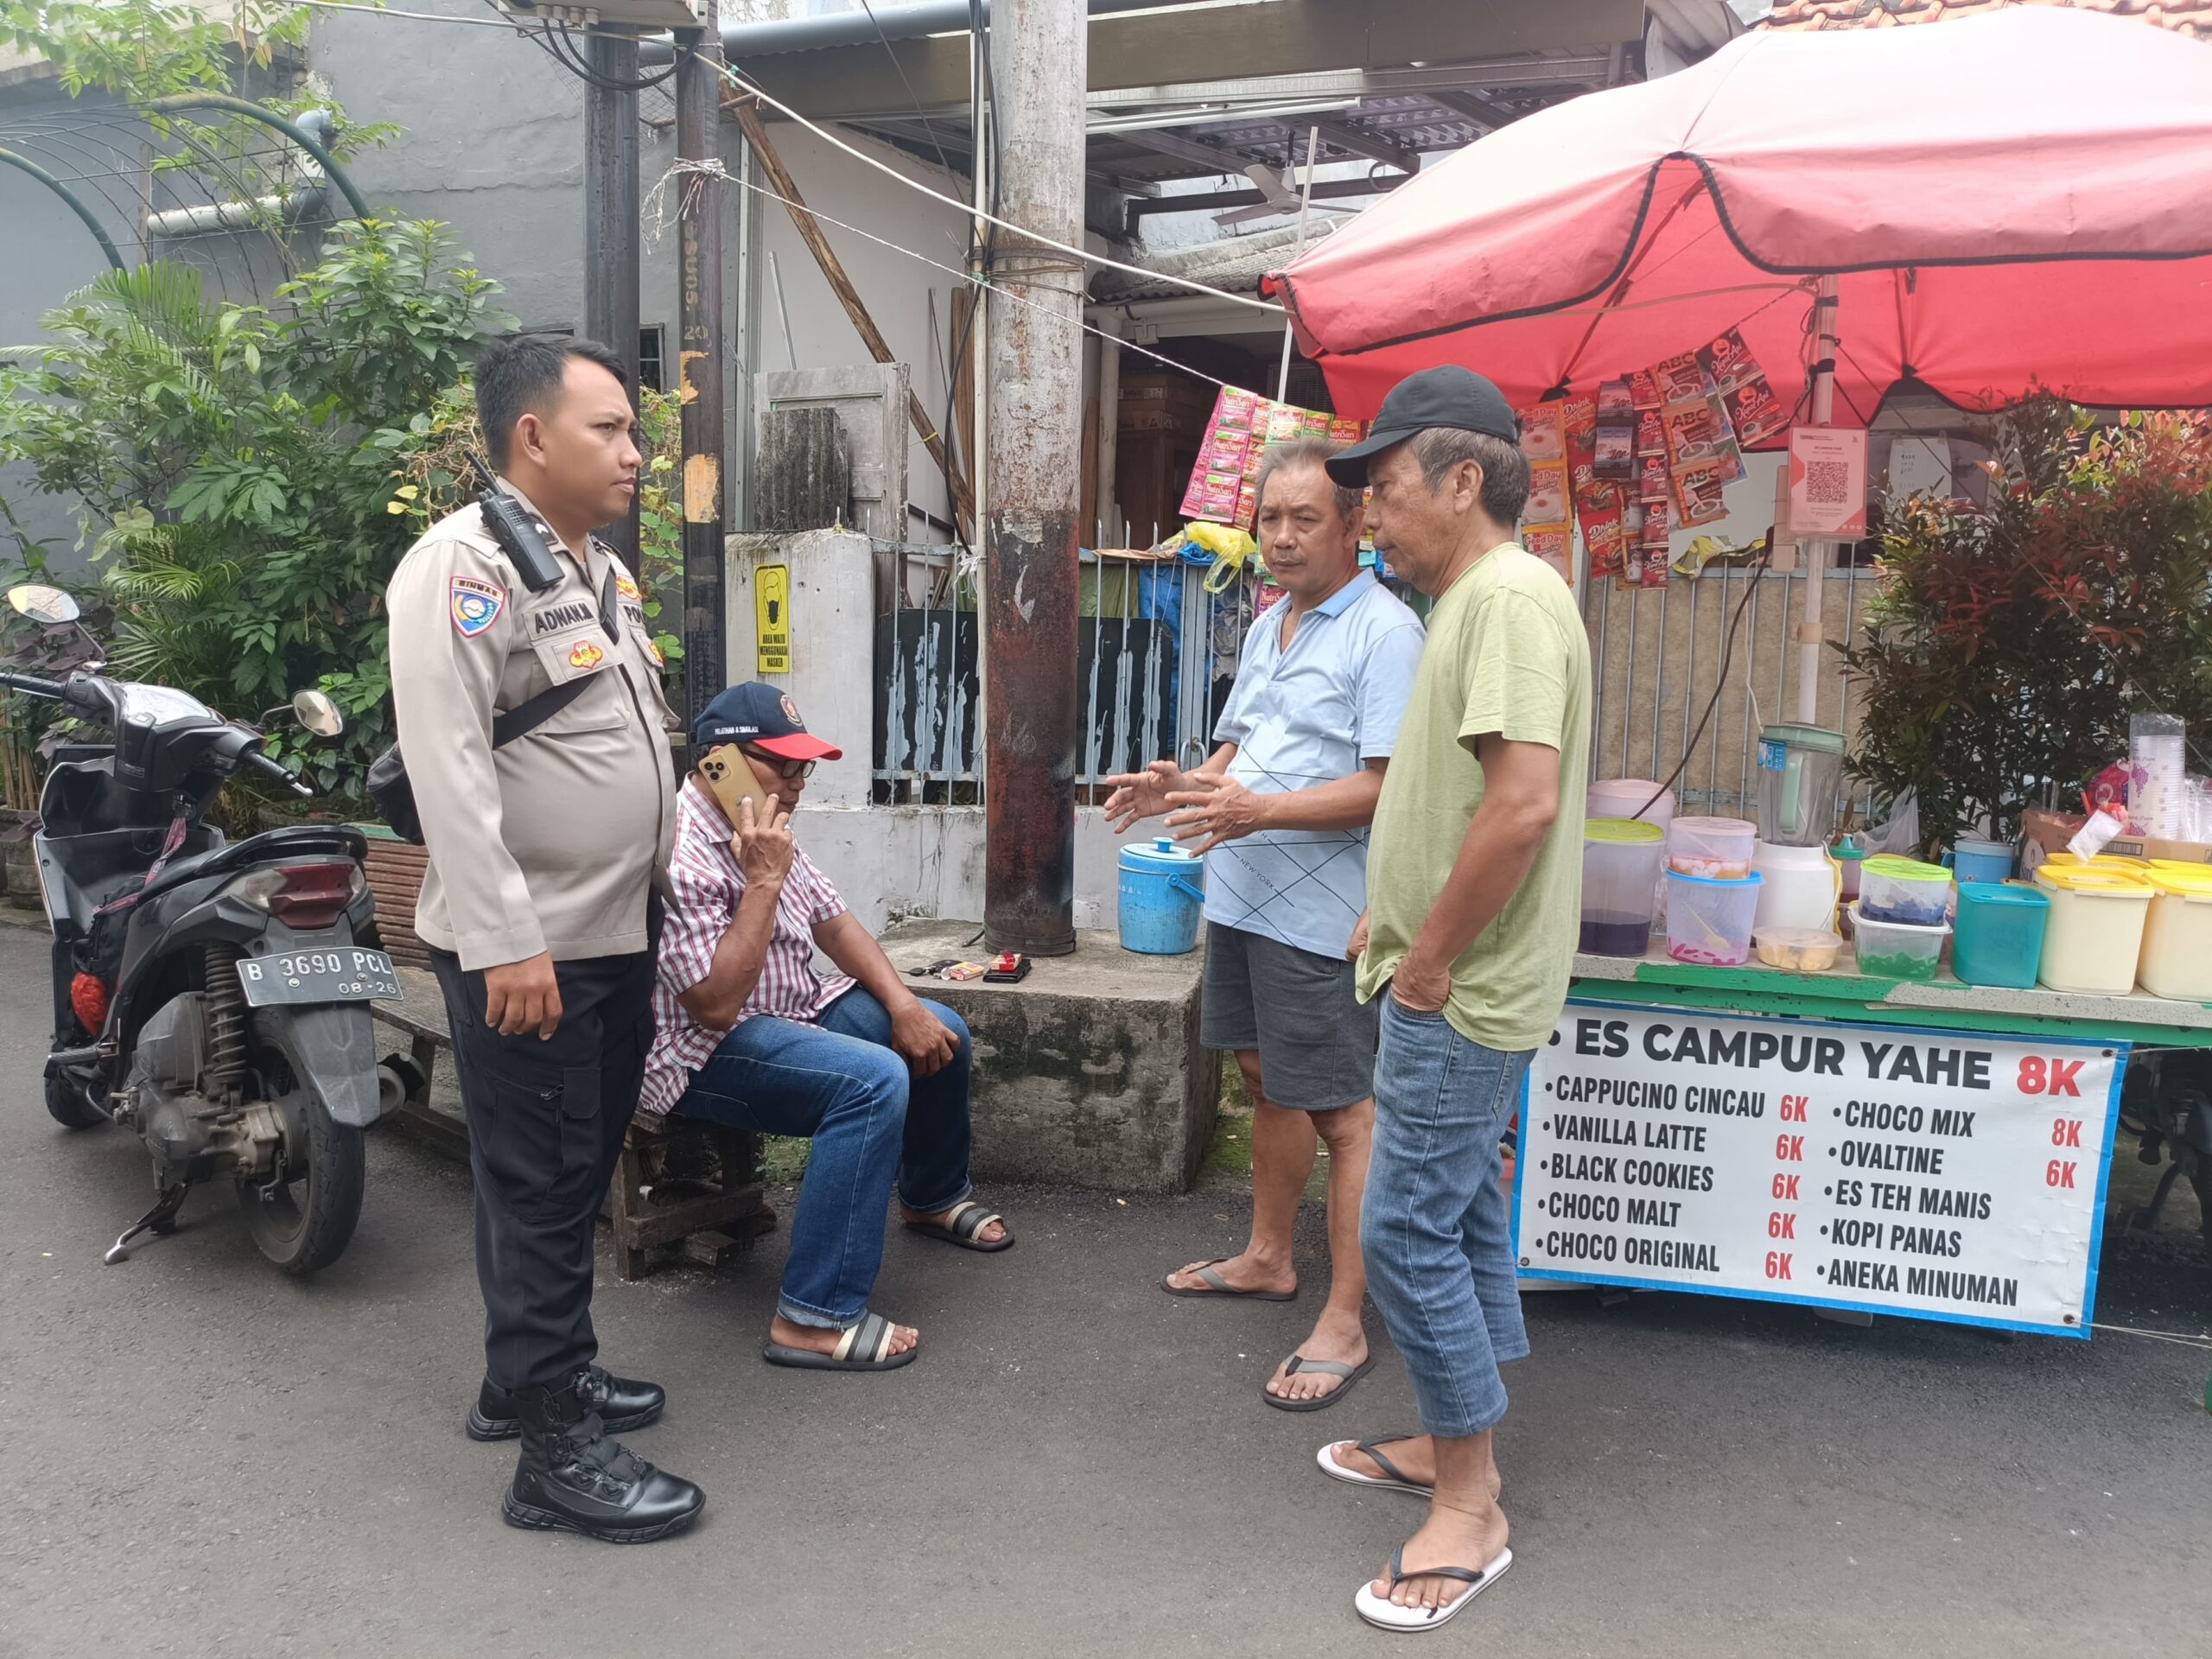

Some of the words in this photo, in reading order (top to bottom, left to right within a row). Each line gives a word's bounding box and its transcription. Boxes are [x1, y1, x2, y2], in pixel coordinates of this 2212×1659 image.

[1658, 352, 1694, 372] ABC
[1306, 419, 1326, 429] triSari
[1563, 397, 1590, 416] Drink
[1672, 409, 1709, 428] ABC
[1329, 429, 1355, 439] utriSari
[1544, 470, 1561, 480] Day
[1683, 467, 1719, 486] ABC
[1524, 534, 1547, 545] Good
[1547, 533, 1564, 545] Day
[1588, 518, 1618, 539] Drink
[1239, 857, 1257, 874] NEW
[1255, 871, 1275, 891] YORK
[247, 963, 263, 981] B
[279, 953, 342, 977] 3690
[1575, 1019, 1629, 1058] ES
[1643, 1023, 1845, 1076] CAMPUR
[1860, 1041, 1993, 1090] YAHE
[2018, 1055, 2085, 1097] 8K
[1556, 1075, 1678, 1113] CAPPUCINO
[1685, 1086, 1765, 1118] CINCAU
[1780, 1095, 1808, 1122] 6K
[1554, 1113, 1637, 1147] VANILLA
[1643, 1122, 1707, 1153] LATTE
[1776, 1134, 1803, 1161] 6K
[1846, 1100, 1923, 1133] CHOCO
[1930, 1109, 1976, 1138] MIX
[2052, 1118, 2082, 1147] 8K
[1551, 1153, 1618, 1183] BLACK
[1624, 1160, 1714, 1192] COOKIES
[1772, 1173, 1800, 1200] 6K
[1841, 1140, 1944, 1175] OVALTINE
[2046, 1160, 2075, 1189] 6K
[1548, 1191, 1620, 1223] CHOCO
[1627, 1198, 1681, 1228] MALT
[1768, 1211, 1795, 1239] 6K
[1836, 1179, 1863, 1207] ES
[1871, 1182, 1912, 1212] TEH
[1919, 1187, 1992, 1220] MANIS
[1547, 1230, 1618, 1262] CHOCO
[1624, 1236, 1719, 1273] ORIGINAL
[1765, 1251, 1792, 1280] 6K
[1832, 1218, 1884, 1249] KOPI
[1891, 1225, 1962, 1258] PANAS
[1827, 1259, 1899, 1293] ANEKA
[1907, 1267, 2018, 1306] MINUMAN
